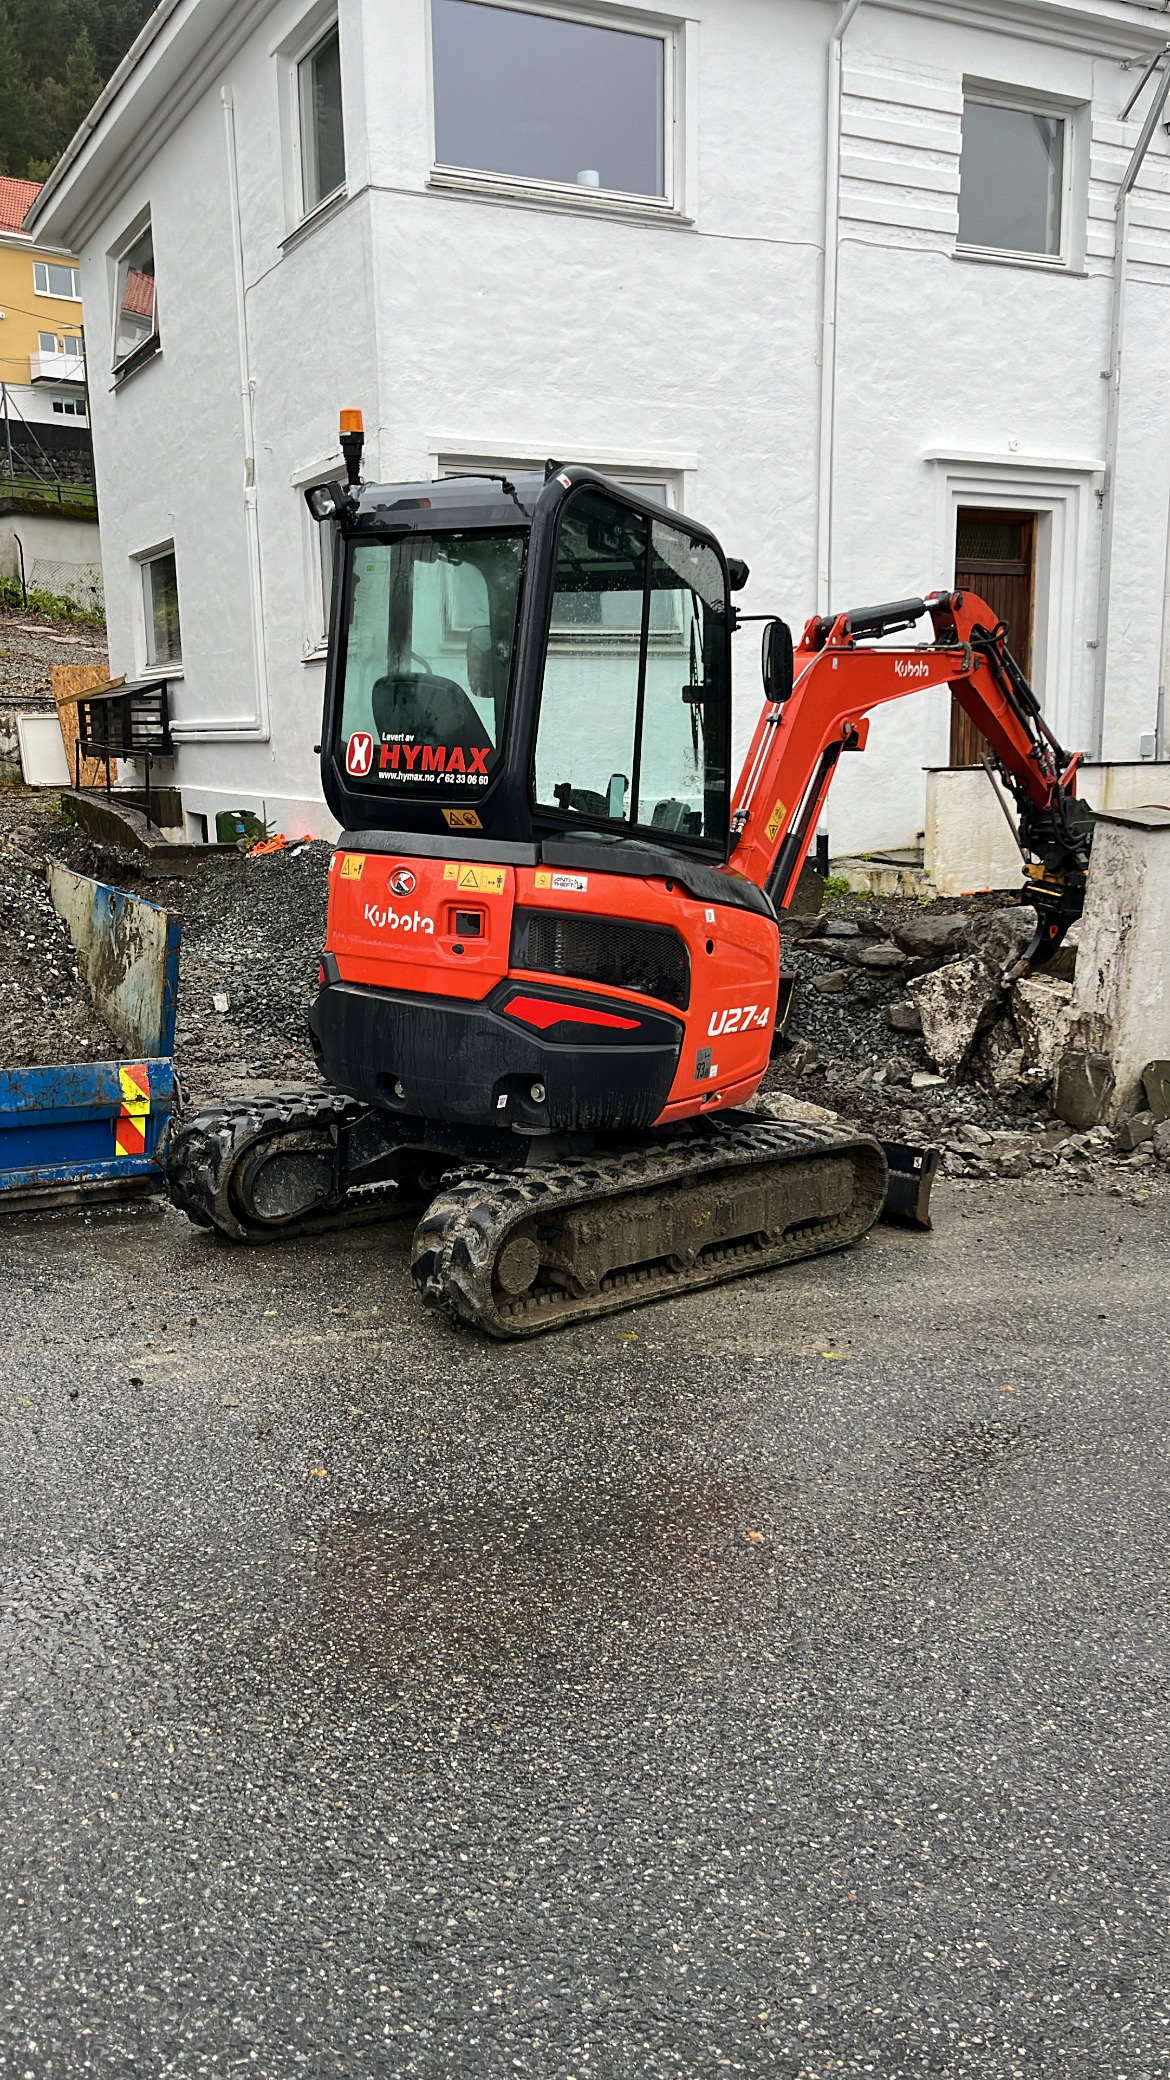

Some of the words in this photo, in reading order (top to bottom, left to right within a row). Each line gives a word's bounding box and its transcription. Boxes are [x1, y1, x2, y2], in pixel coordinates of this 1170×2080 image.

[894, 659, 929, 677] Kubota
[382, 732, 404, 742] Levert
[405, 734, 415, 742] av
[379, 743, 491, 774] HYMAX
[378, 771, 435, 782] www.hymax.no
[444, 774, 455, 783] 62
[455, 774, 466, 784] 33
[467, 775, 478, 784] 06
[478, 775, 489, 785] 60
[364, 903, 434, 935] Kubota
[707, 1004, 770, 1037] U27-4
[696, 1061, 706, 1079] 93
